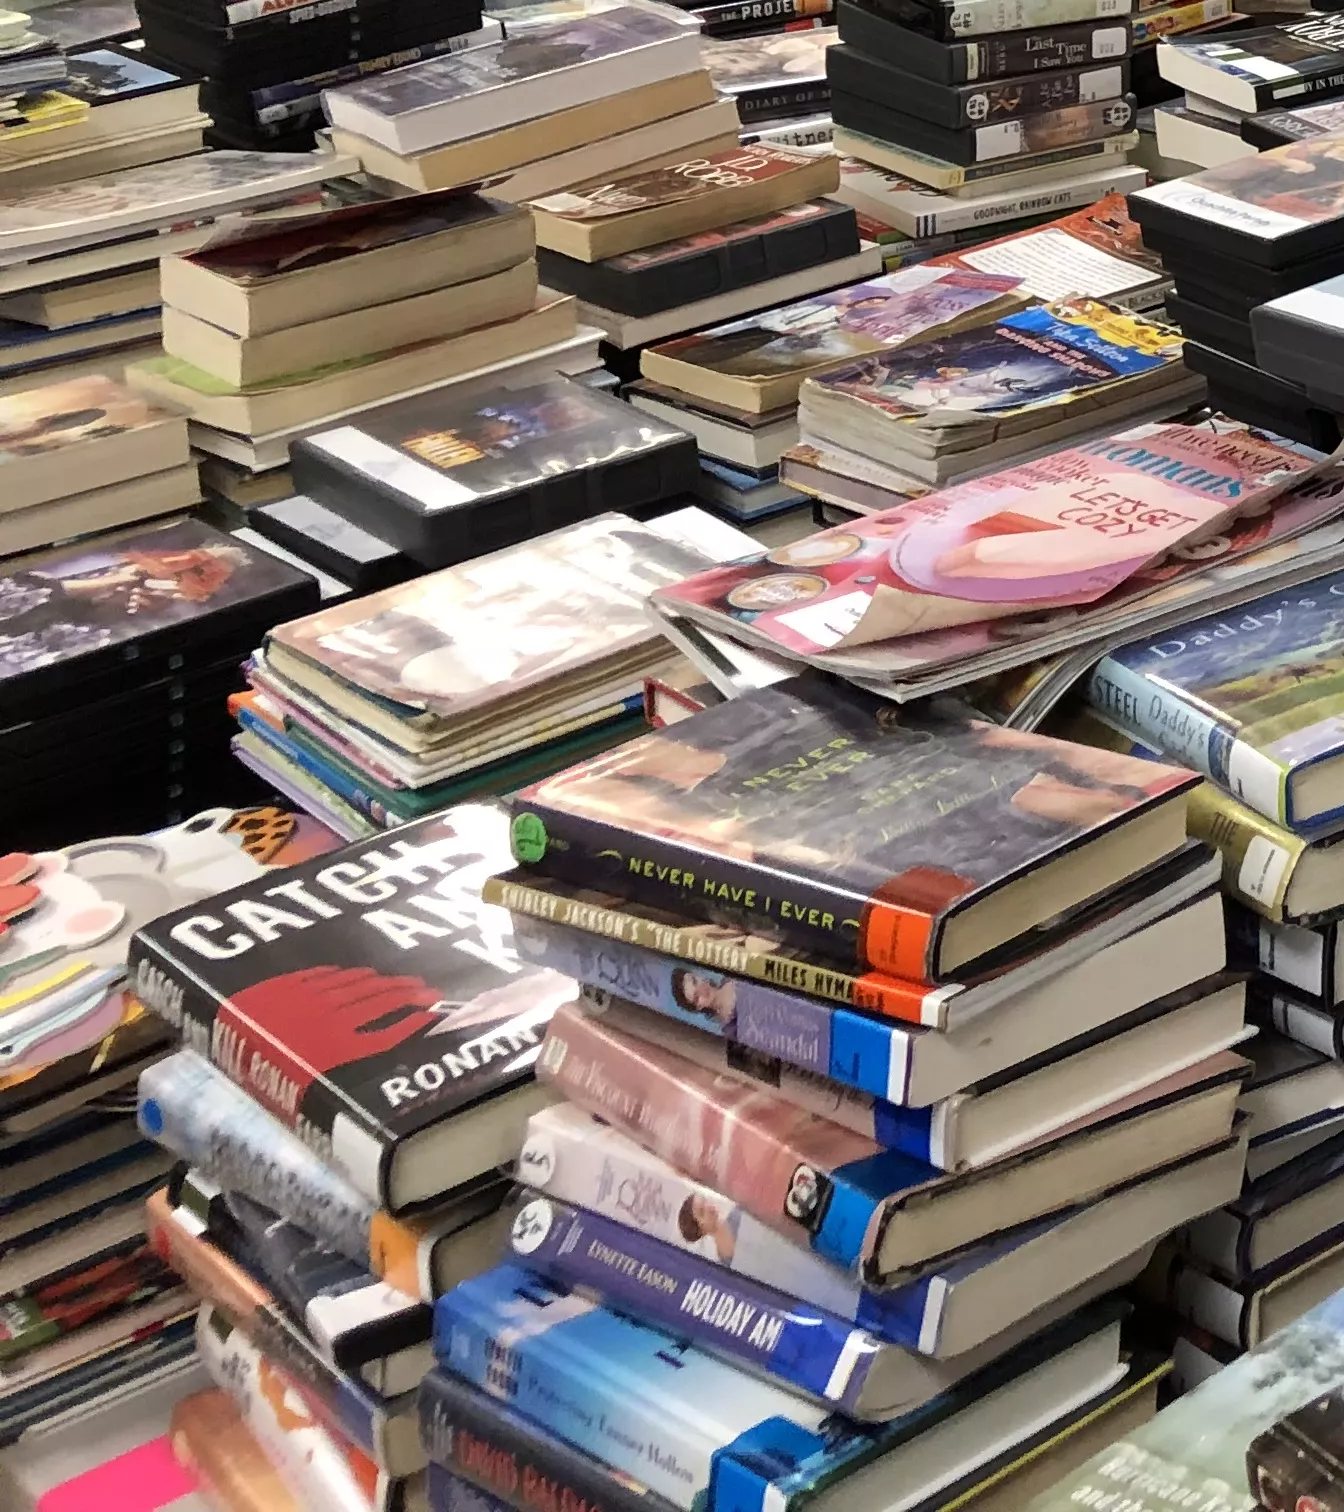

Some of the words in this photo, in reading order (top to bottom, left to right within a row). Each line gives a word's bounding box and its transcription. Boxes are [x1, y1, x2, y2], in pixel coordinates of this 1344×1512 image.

[1025, 36, 1055, 53] Last
[1055, 41, 1087, 55] Time
[1276, 21, 1340, 42] BOY
[1041, 56, 1061, 68] Saw
[1065, 53, 1084, 65] You
[744, 95, 789, 110] DIARY
[796, 92, 813, 102] OF
[1316, 78, 1326, 90] IN
[665, 158, 754, 188] ROBB
[973, 201, 1016, 220] GOODNIGHT,
[1053, 192, 1072, 207] CATS
[1057, 506, 1149, 540] COZY
[1136, 510, 1200, 531] GET
[1149, 597, 1318, 660] Daddy's
[1099, 675, 1141, 727] STEEL
[1148, 694, 1206, 748] Daddy's
[742, 737, 856, 789] NEVER
[786, 749, 876, 790] EVER
[1211, 812, 1240, 846] THE
[170, 840, 438, 961] CATCH
[629, 856, 696, 890] NEVER
[704, 879, 757, 908] HAVE
[765, 896, 772, 913] I
[779, 899, 836, 931] EVER
[502, 885, 559, 920] SHIRLEY
[564, 898, 640, 943] JACKSON'S
[764, 957, 808, 989] MILES
[380, 1020, 542, 1111] RONAN
[588, 1239, 639, 1278] LYNETTE
[637, 1259, 678, 1294] EASON
[680, 1278, 755, 1337] HOLIDAY
